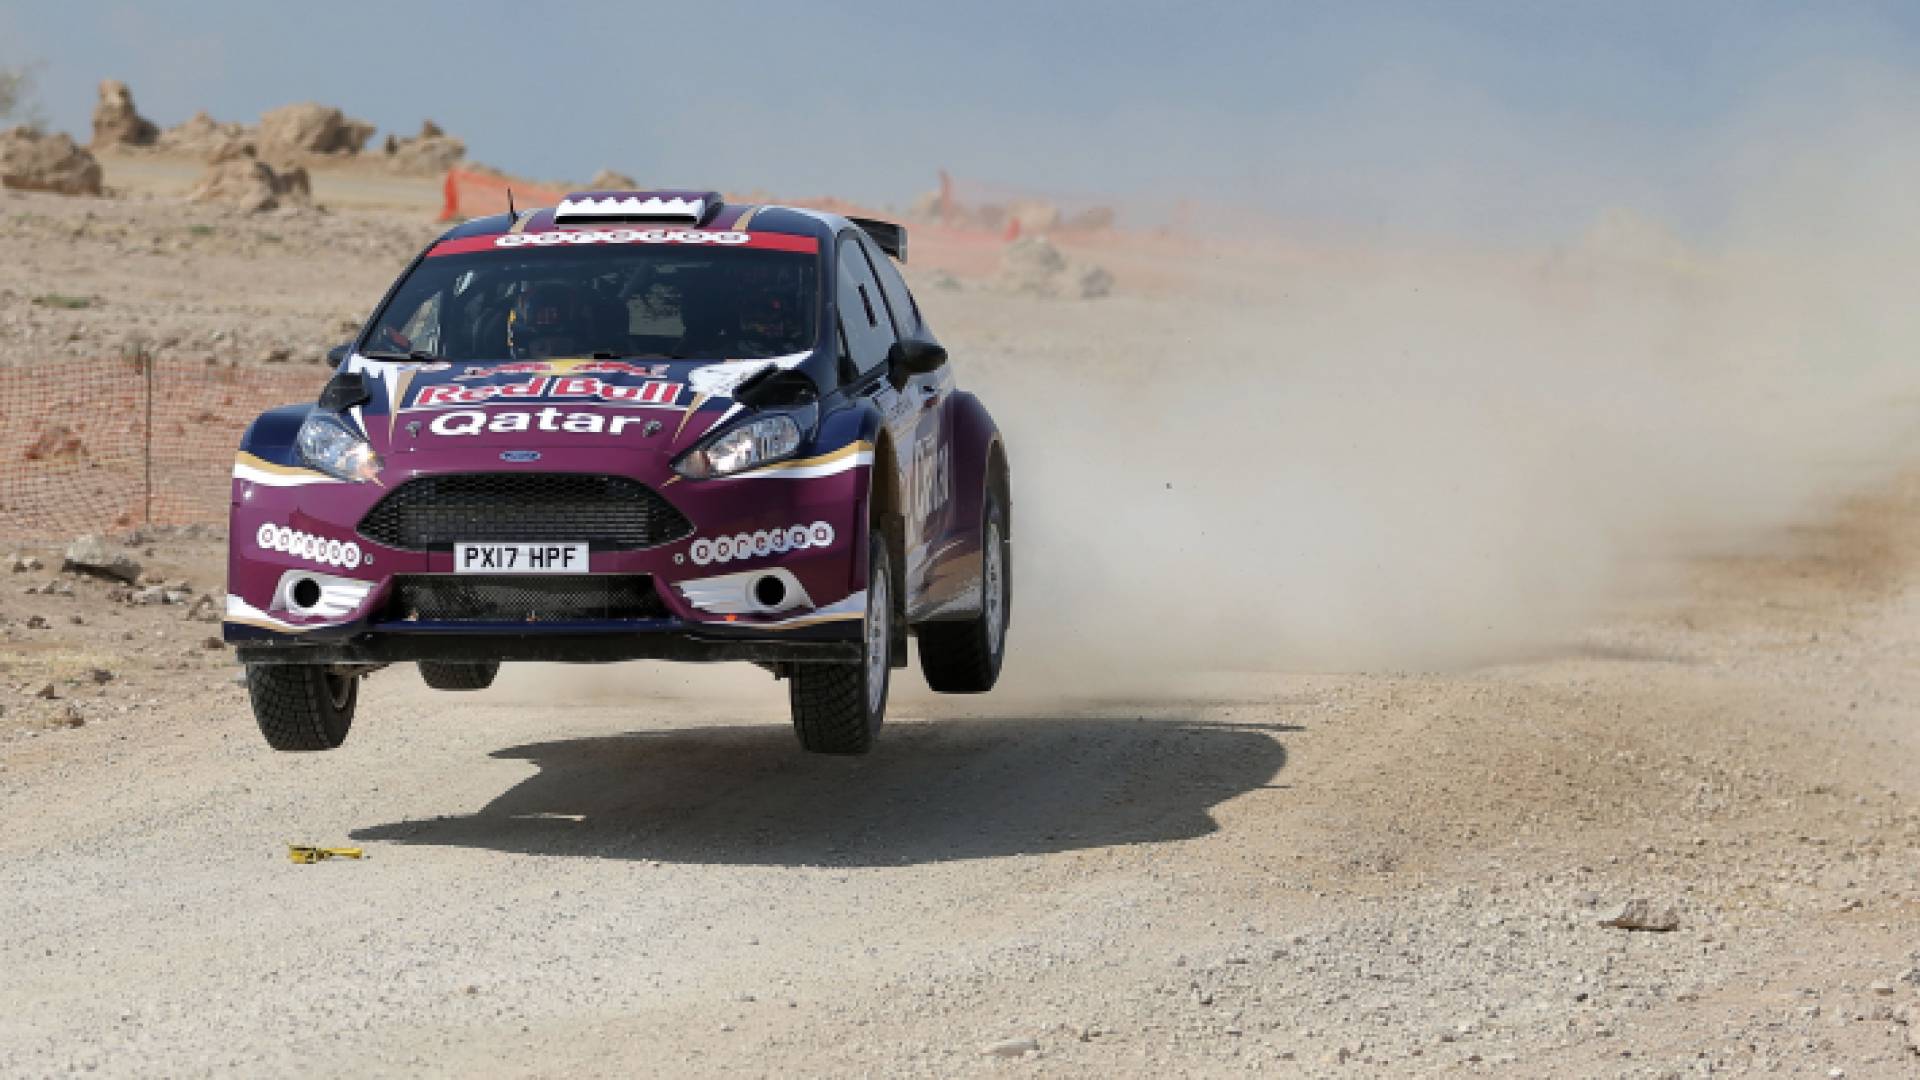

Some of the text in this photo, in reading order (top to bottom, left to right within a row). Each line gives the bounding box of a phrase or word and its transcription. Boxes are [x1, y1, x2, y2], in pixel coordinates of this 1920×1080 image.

[412, 376, 684, 405] Red Bull
[430, 407, 640, 436] Qatar
[464, 547, 577, 568] PX17 HPF
[690, 521, 834, 565] ooredoo
